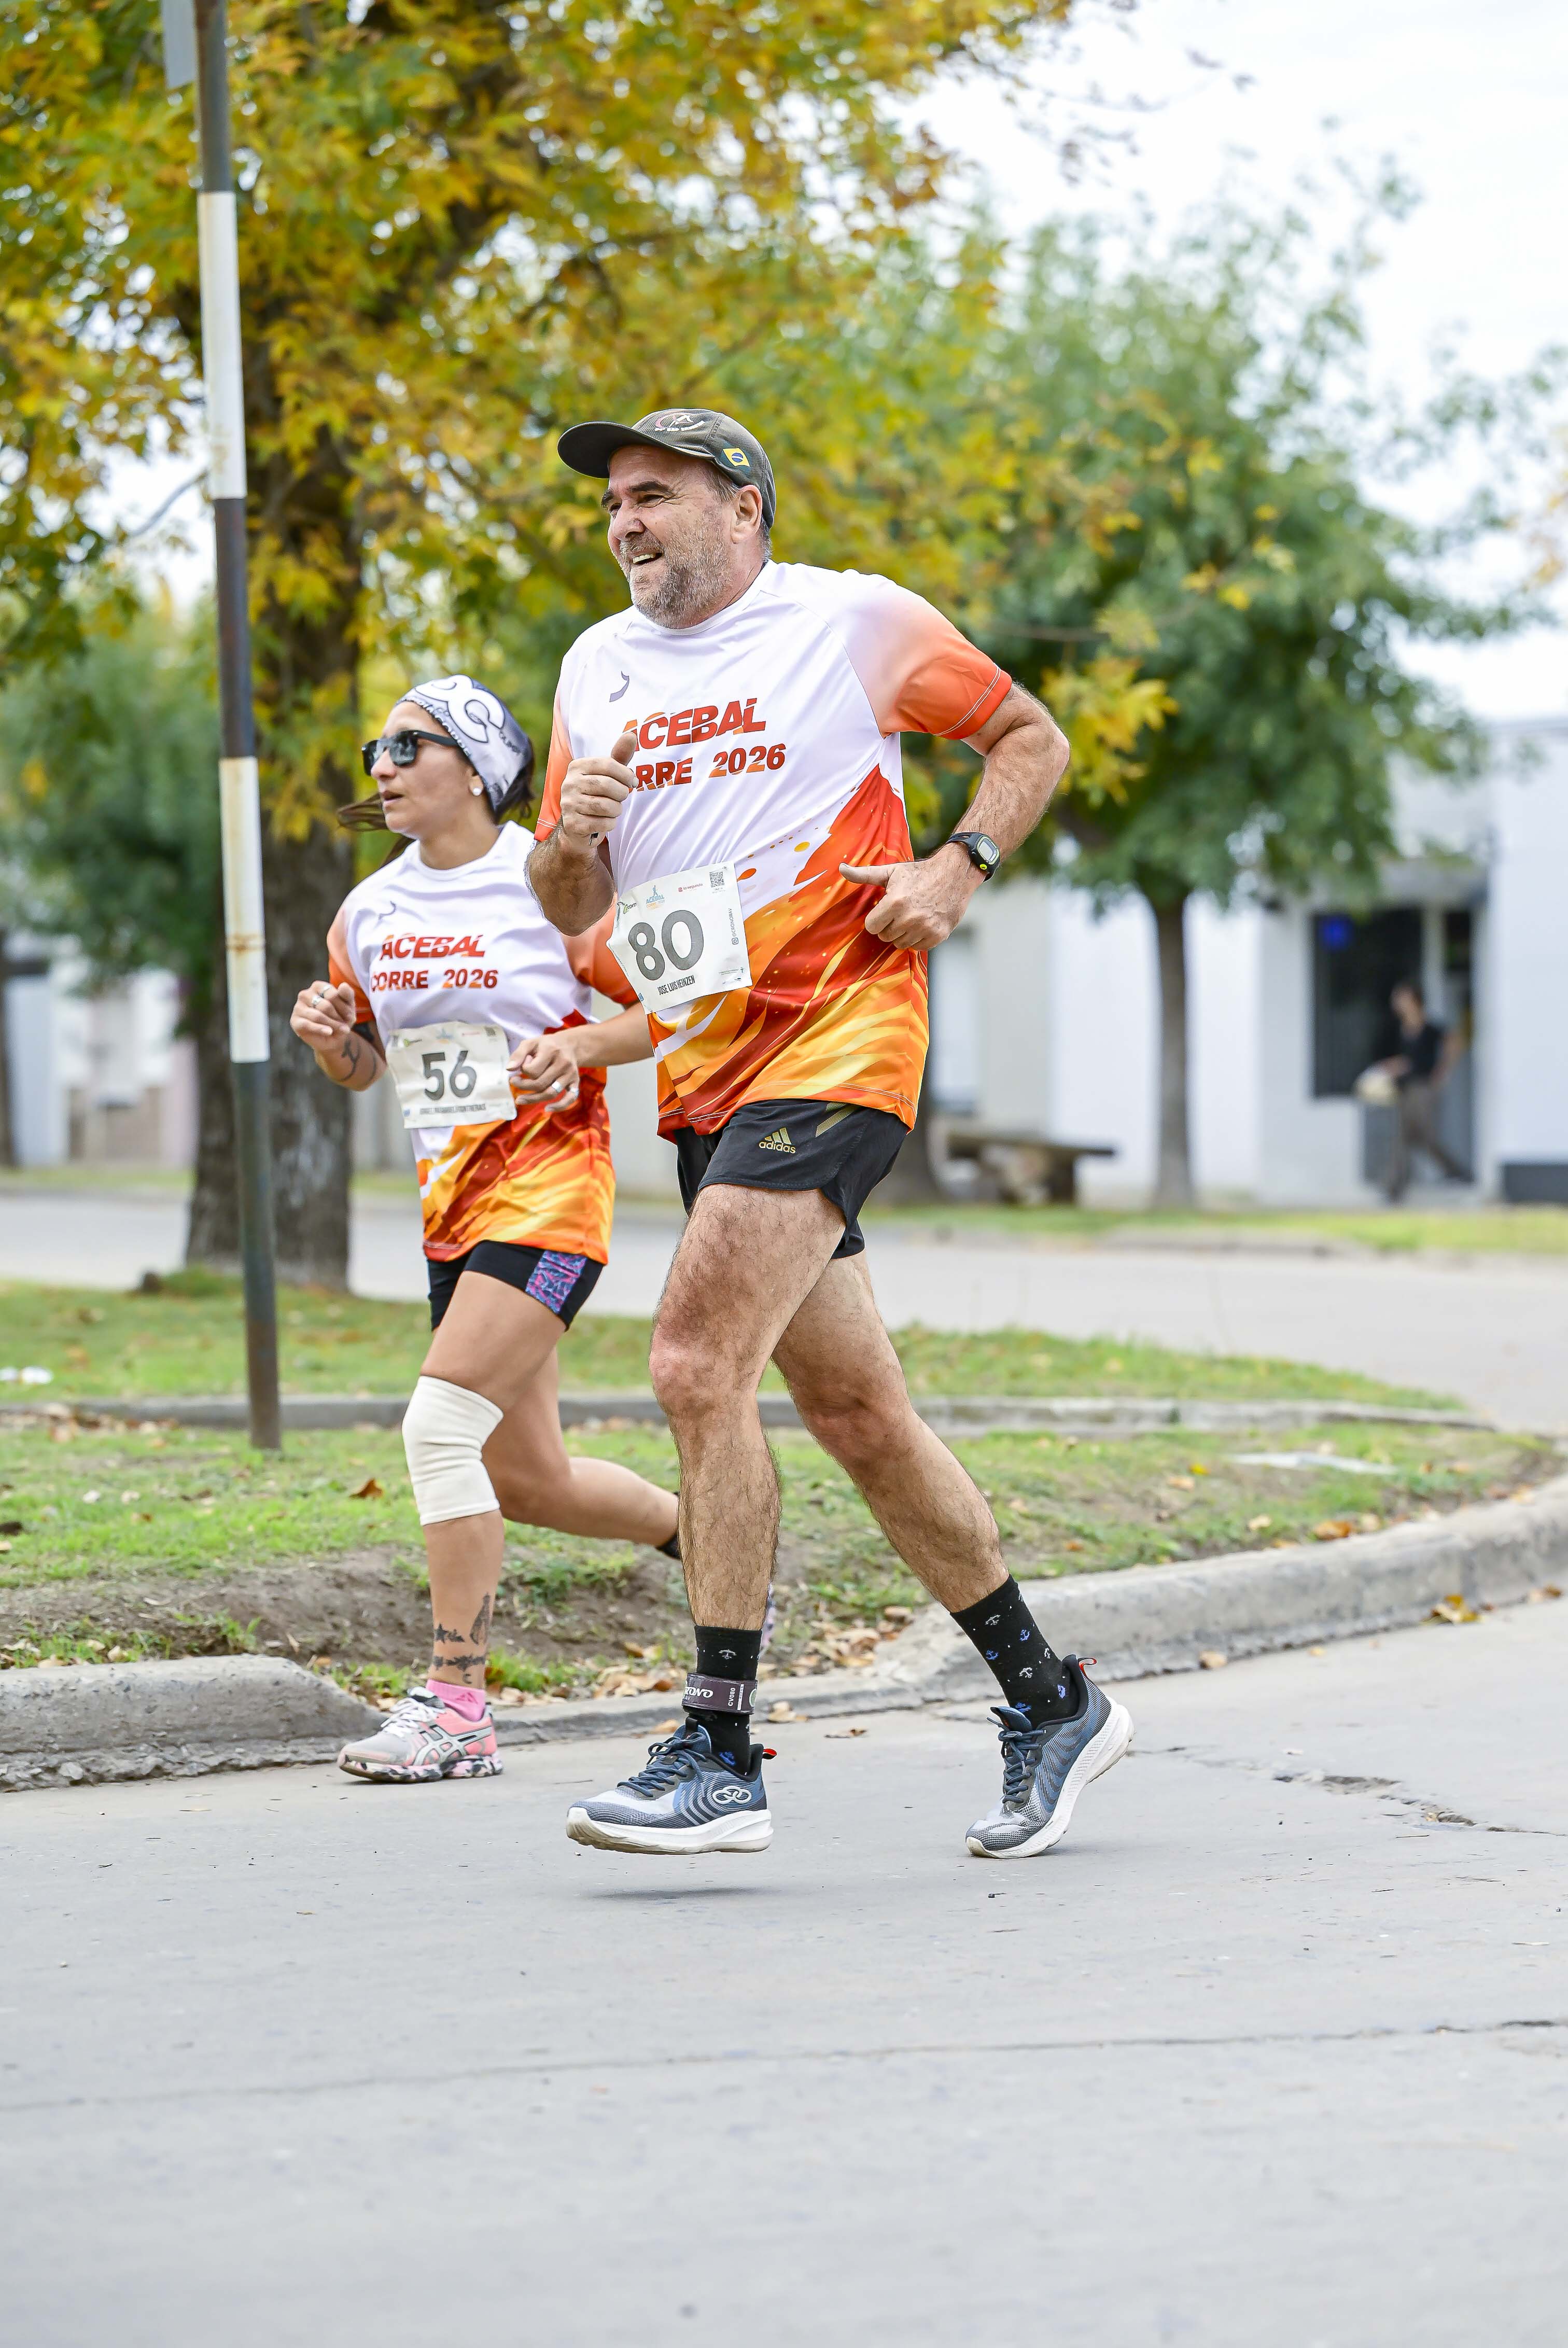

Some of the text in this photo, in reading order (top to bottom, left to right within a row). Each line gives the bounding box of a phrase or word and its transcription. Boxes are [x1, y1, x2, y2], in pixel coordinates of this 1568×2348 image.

[622, 698, 766, 751] ACEBAL
[709, 743, 786, 778] 2026
[728, 908, 737, 937] @CRONORAV
[380, 933, 485, 961] ACEBAL
[628, 910, 704, 981] 80
[442, 969, 498, 989] 2026
[657, 975, 695, 995] JOSE LUIS HEINZEN
[422, 1050, 477, 1100] 56
[759, 1141, 796, 1154] adidas
